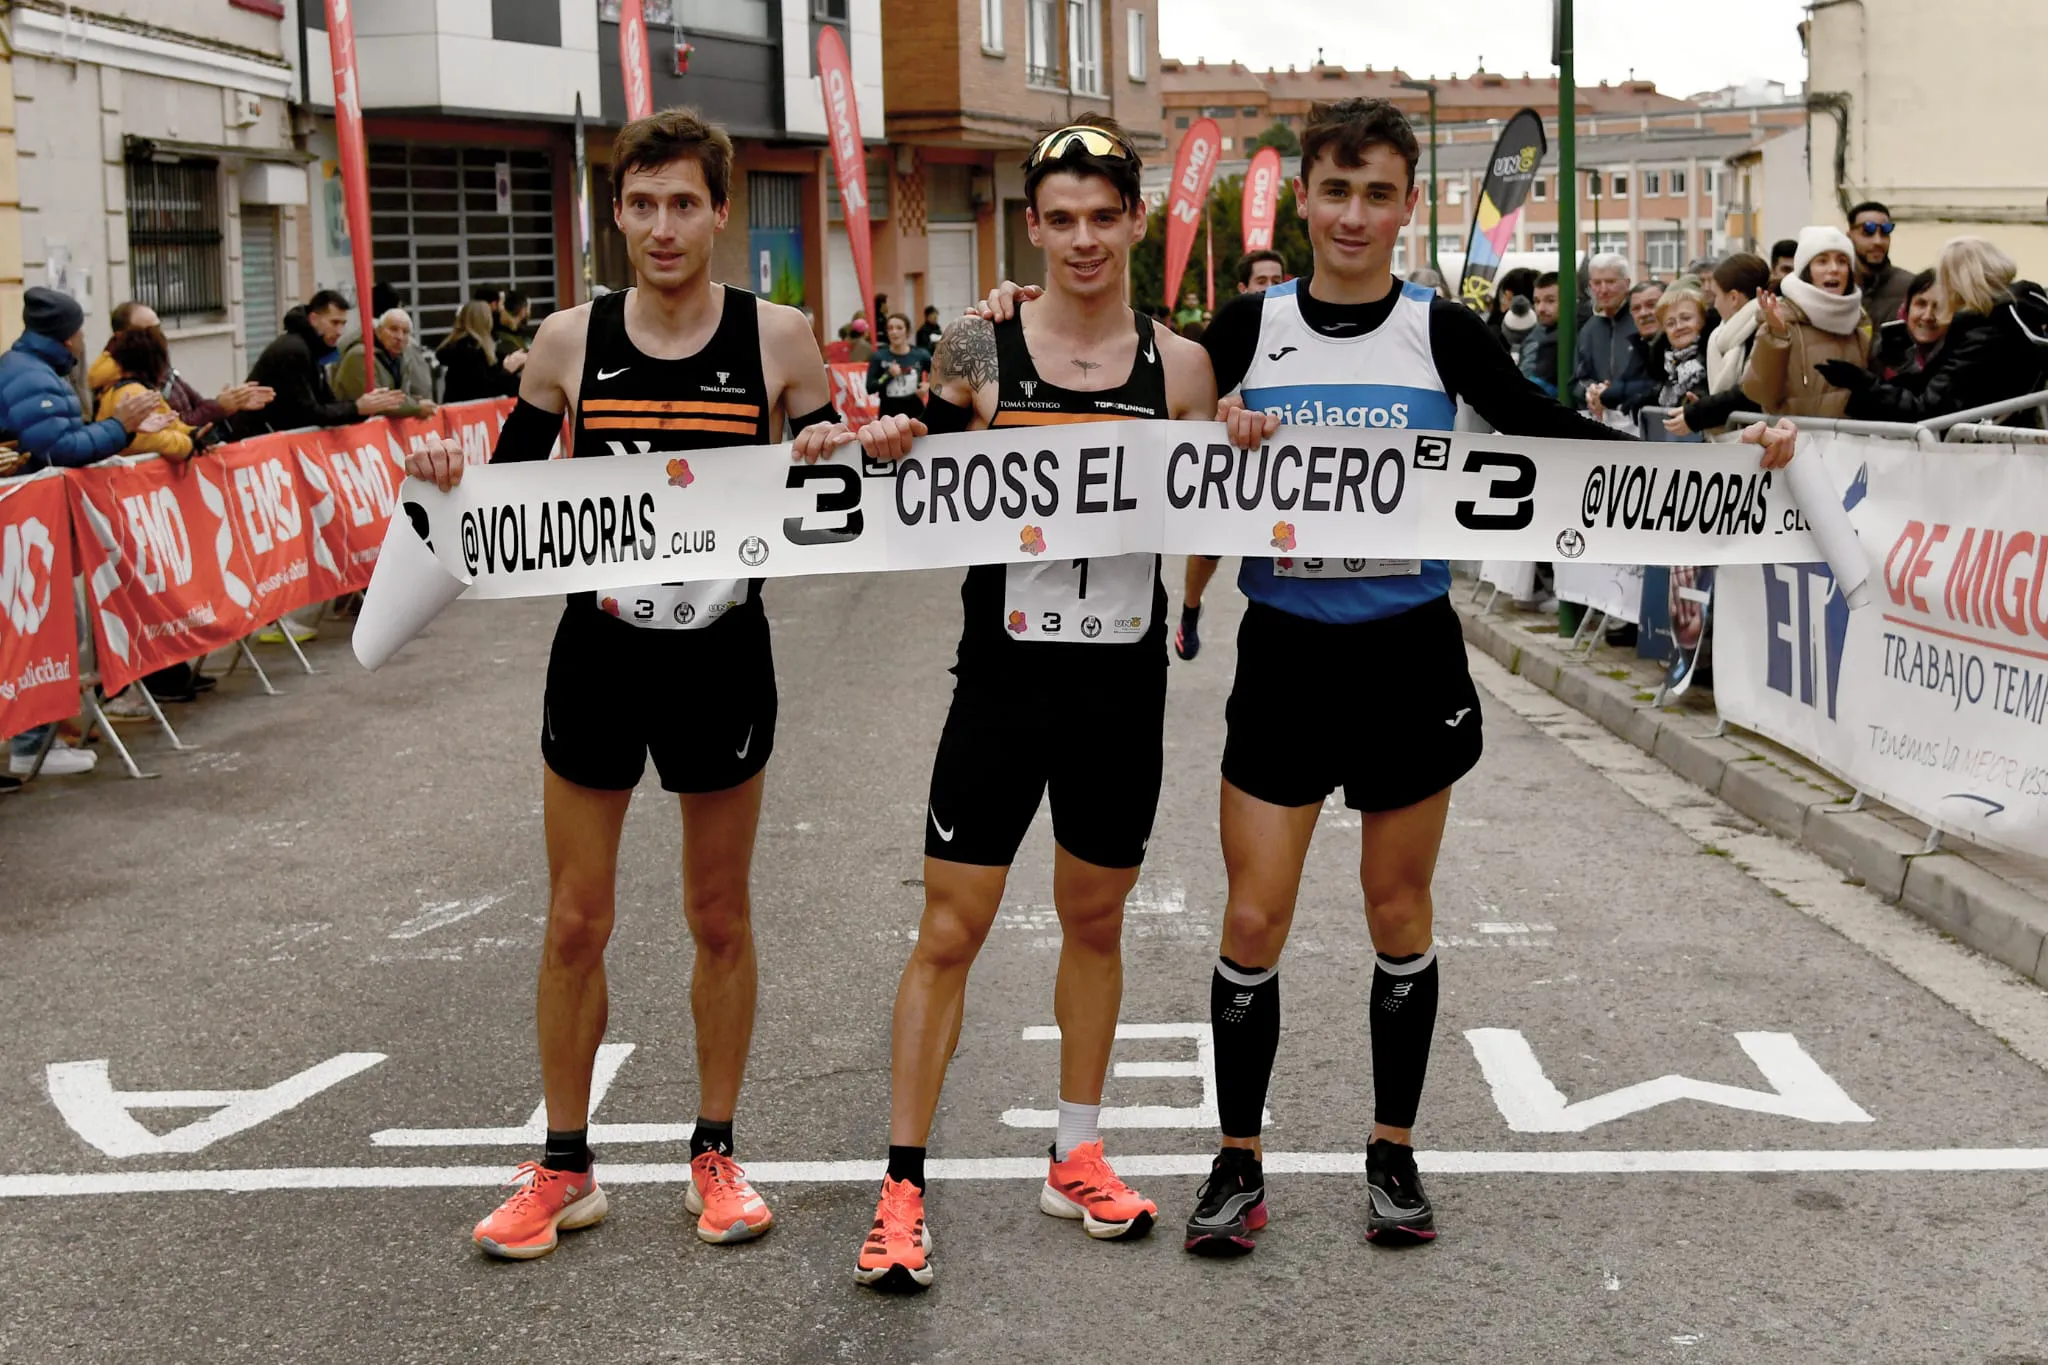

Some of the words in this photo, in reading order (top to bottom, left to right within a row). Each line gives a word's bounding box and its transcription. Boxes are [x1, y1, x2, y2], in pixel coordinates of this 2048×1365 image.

[1181, 138, 1209, 193] EMD
[1252, 167, 1270, 218] EMD
[1000, 400, 1026, 408] TOMÁS
[1027, 401, 1061, 409] POSTIGO
[329, 443, 395, 528] EMD
[895, 449, 1060, 526] CROSS
[1076, 446, 1138, 514] EL
[1166, 442, 1406, 515] CRUCERO
[1416, 438, 1448, 468] 3
[783, 464, 864, 546] 3
[1455, 450, 1537, 531] 3
[1581, 464, 1772, 535] @VOLADORAS
[1775, 509, 1811, 535] _CL
[122, 486, 193, 596] EMD
[461, 492, 656, 577] @VOLADORAS
[1883, 519, 1950, 615] DE
[633, 599, 655, 619] 3
[1072, 558, 1088, 600] 1
[1041, 612, 1062, 632] 3
[1883, 632, 1985, 713] TRABAJO
[1867, 723, 1941, 768] Tenemos
